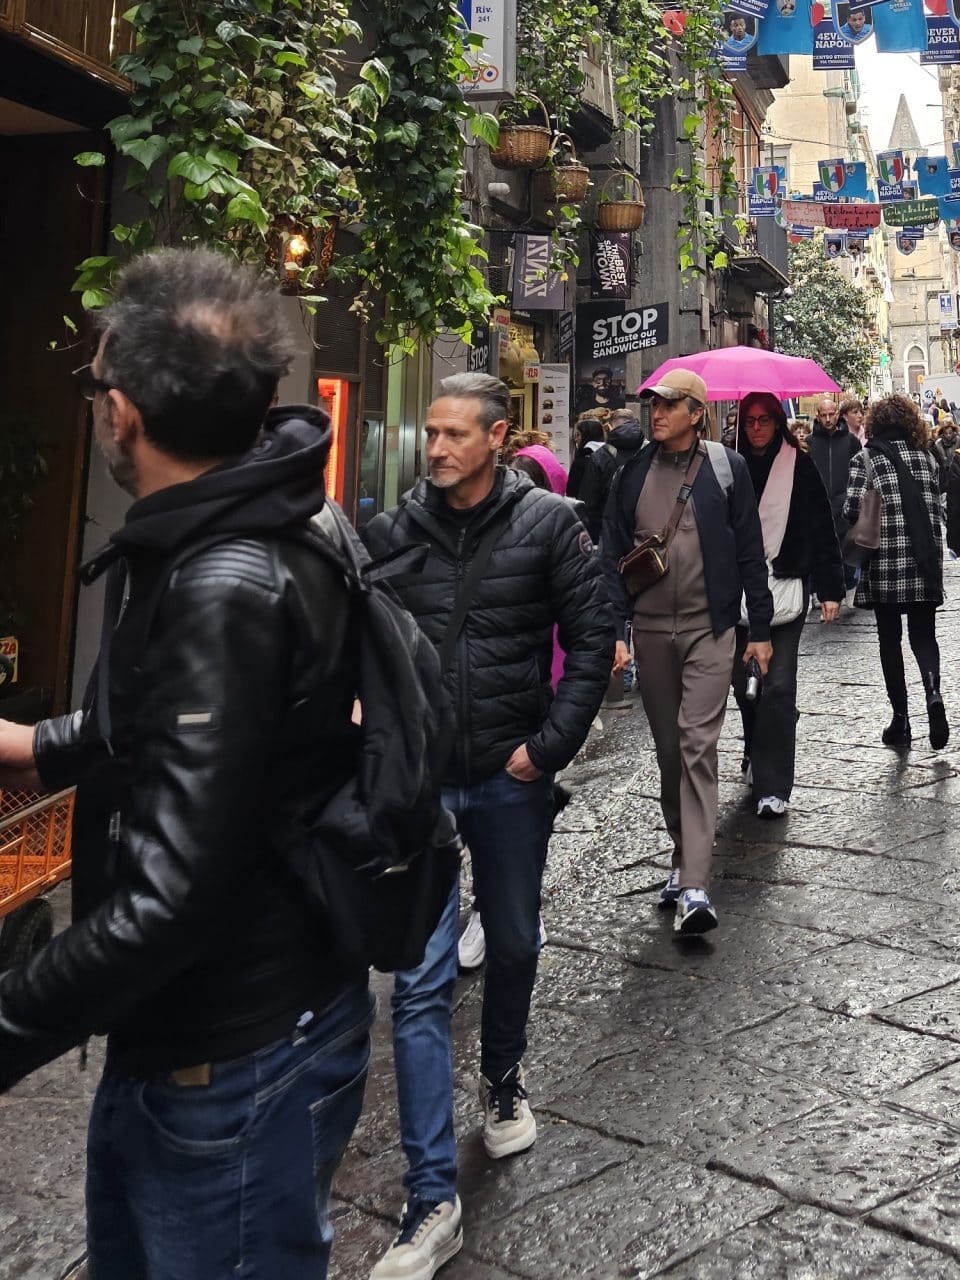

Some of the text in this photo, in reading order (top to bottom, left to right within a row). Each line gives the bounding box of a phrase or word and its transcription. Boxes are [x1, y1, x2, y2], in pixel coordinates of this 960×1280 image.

[475, 6, 493, 14] Riv.
[927, 27, 955, 36] EVER
[596, 250, 613, 290] TOWN
[603, 240, 619, 286] SANDWICH
[615, 259, 627, 286] BEST
[592, 308, 658, 341] STOP
[592, 337, 658, 359] SANDWICHES
[593, 328, 657, 350] and taste our
[470, 345, 489, 371] STOP
